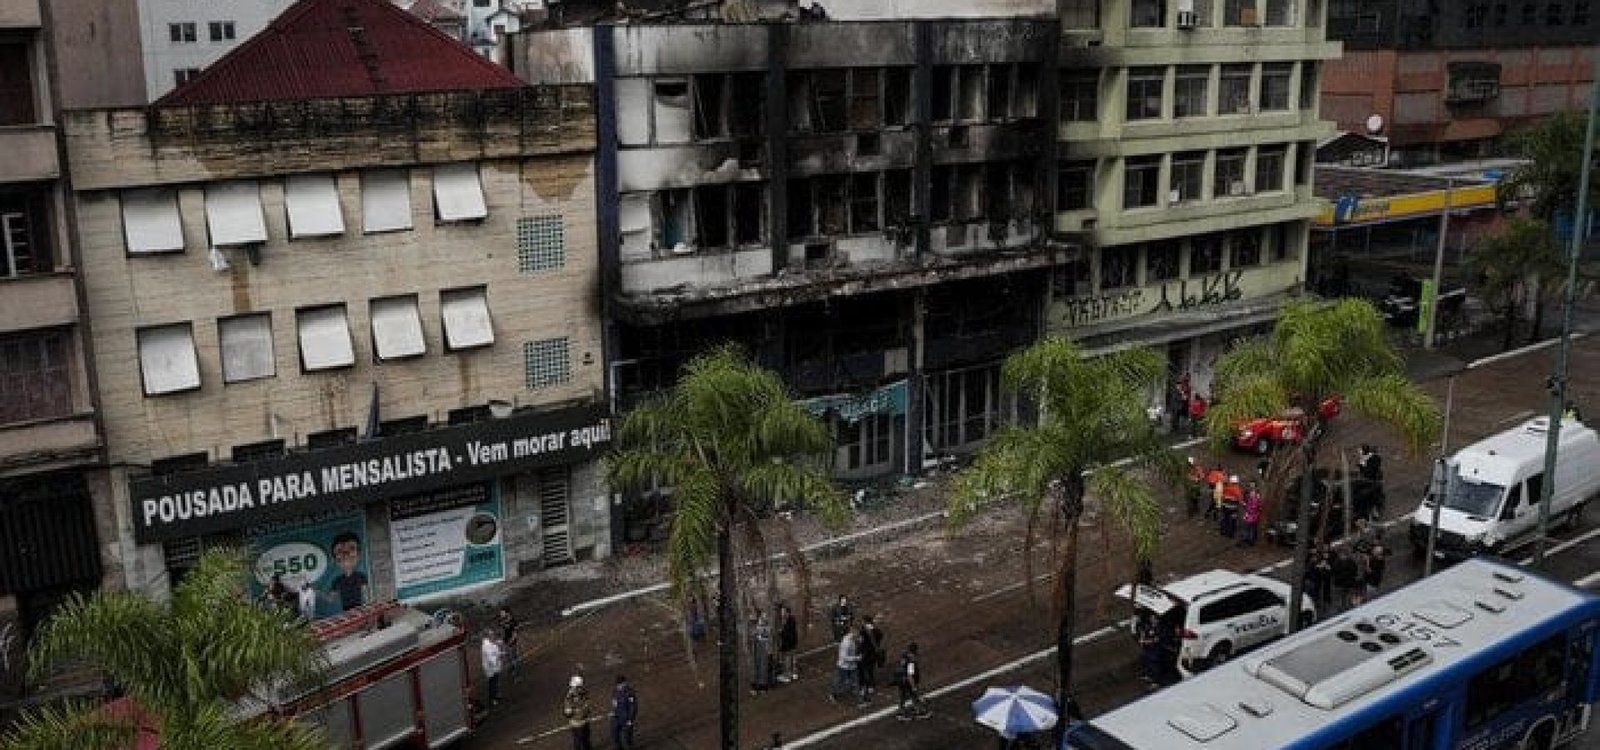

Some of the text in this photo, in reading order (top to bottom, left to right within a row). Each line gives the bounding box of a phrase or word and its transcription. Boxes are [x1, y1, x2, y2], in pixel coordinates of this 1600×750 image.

[143, 482, 254, 526] POUSADA
[258, 470, 316, 505] PARA
[322, 446, 452, 494] MENSALISTA
[467, 440, 508, 465] Vem
[513, 431, 565, 458] morar
[570, 418, 611, 449] aqui!
[273, 552, 318, 577] 550
